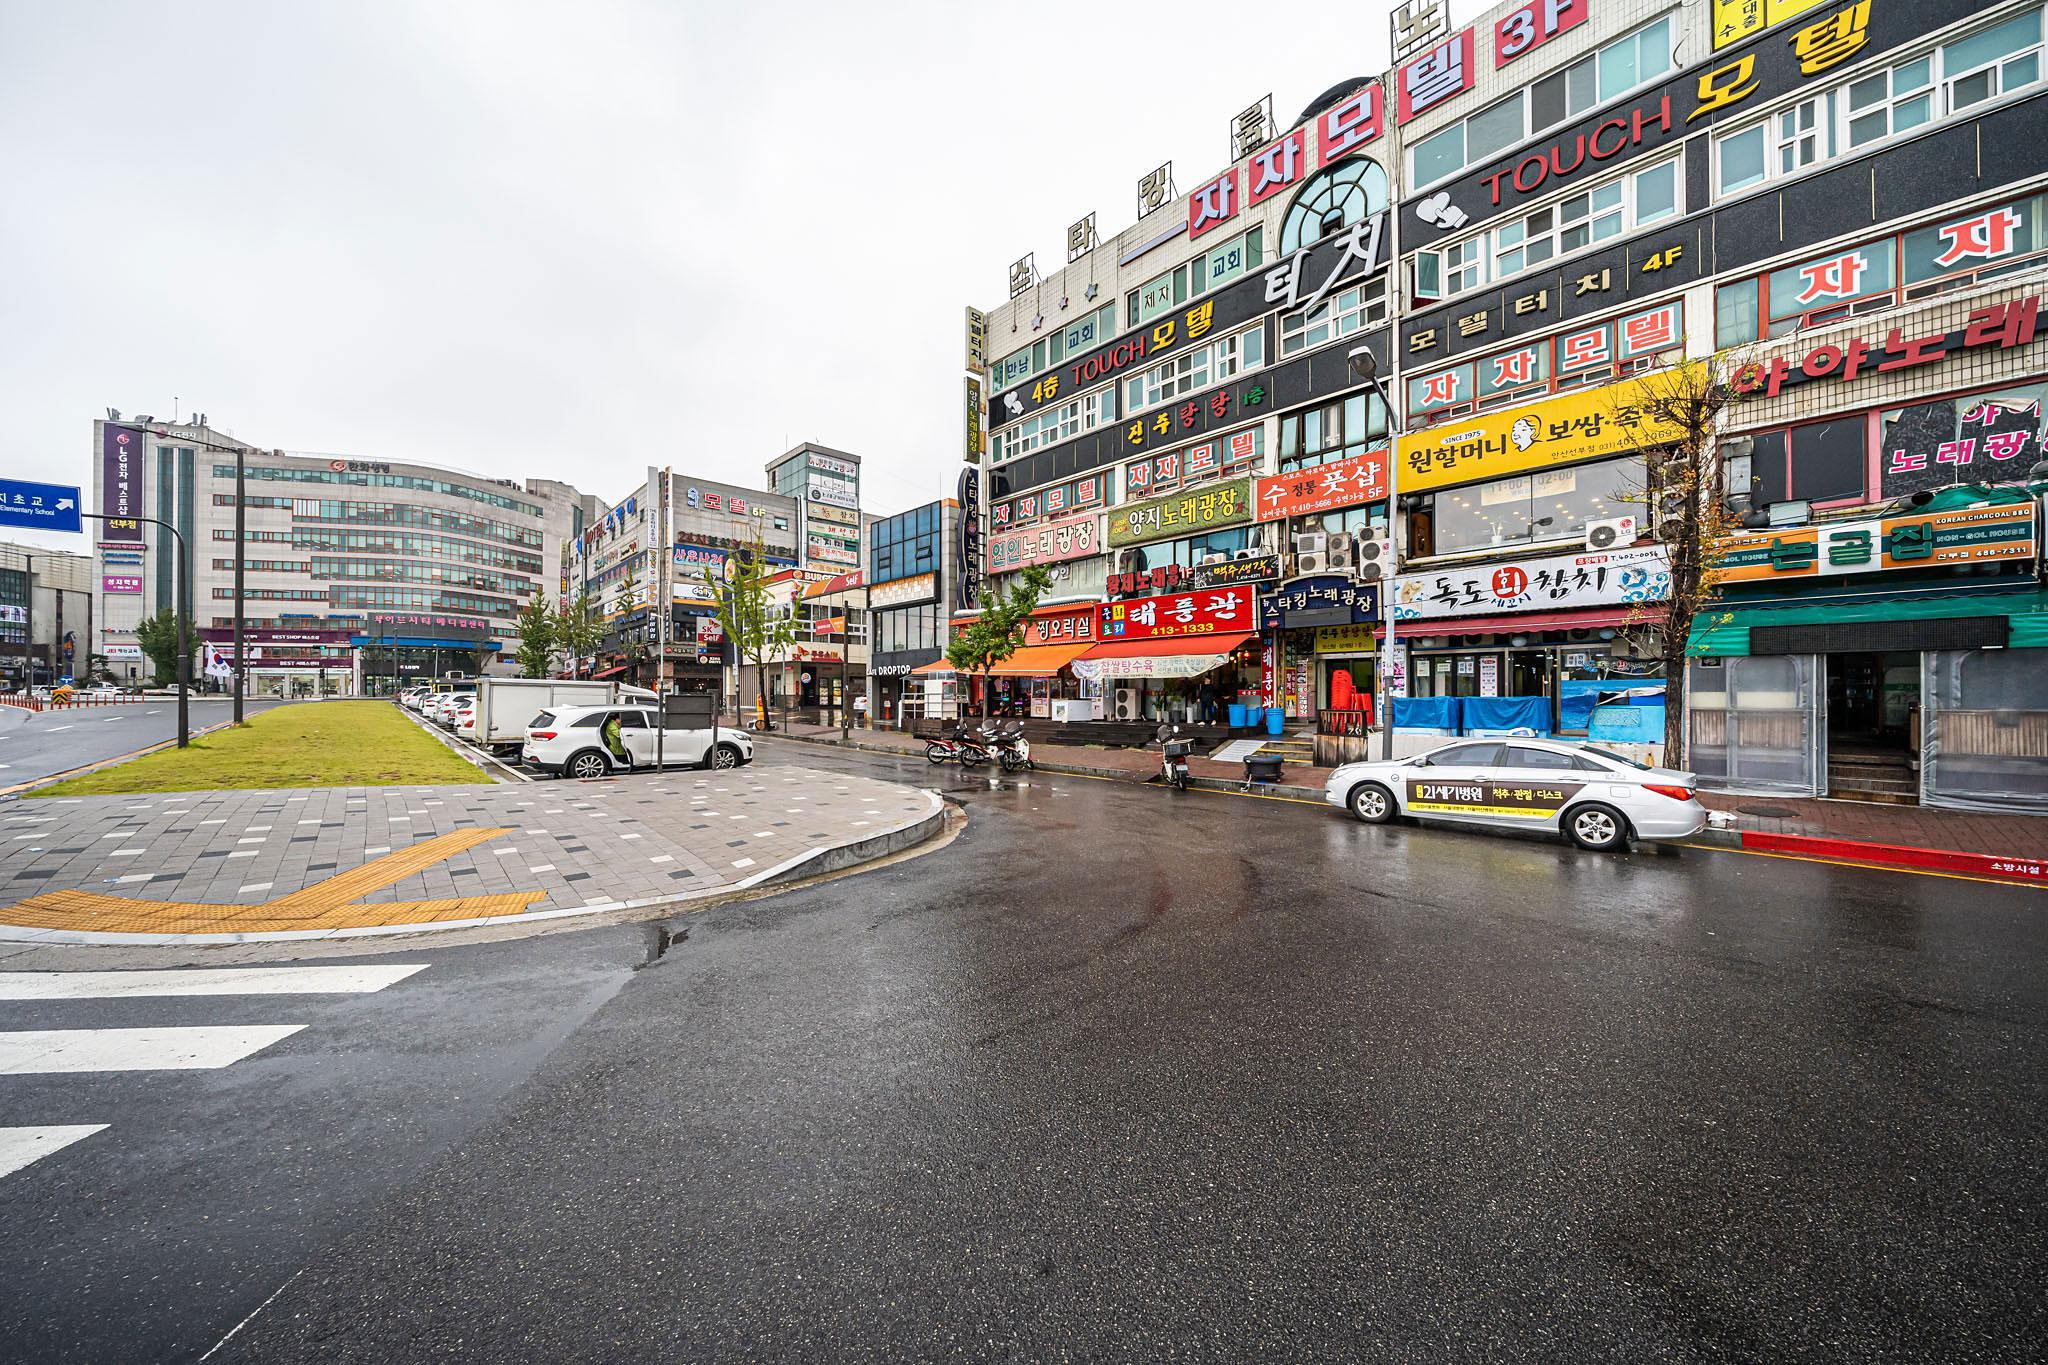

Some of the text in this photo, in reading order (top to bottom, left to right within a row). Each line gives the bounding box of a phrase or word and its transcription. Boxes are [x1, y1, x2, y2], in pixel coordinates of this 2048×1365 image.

[1480, 0, 1873, 206] TOUCH 모텔
[1213, 247, 1241, 278] 교회
[1264, 213, 1384, 316] 터치
[1641, 244, 1683, 273] 4F
[1007, 323, 1094, 380] 만남 교회
[1032, 300, 1215, 404] 4층 TOUCH 모텔
[1445, 431, 1482, 444] SINCE 1975
[1407, 433, 1507, 474] 원할머니
[1262, 460, 1381, 507] 수 정통 풋샵
[1368, 486, 1383, 499] 5F
[34, 508, 55, 517] School
[1936, 508, 2030, 524] KOREAN CHARCOAL BBQ
[968, 476, 979, 600] 스타킹 노래광장
[1936, 527, 2026, 543] NON-GOL HOUSE
[845, 574, 858, 586] Self
[1428, 576, 1489, 610] 독도
[1532, 566, 1608, 600] 참치
[1308, 585, 1373, 613] 노래광장
[1490, 593, 1532, 609] 세꼬시
[1151, 622, 1214, 637] 413-1333
[878, 664, 911, 676] DROPTOP
[1101, 659, 1154, 674] 찹쌀탕수육
[1423, 785, 1483, 802] 21세기병원
[1991, 862, 2040, 875] 소방시설
